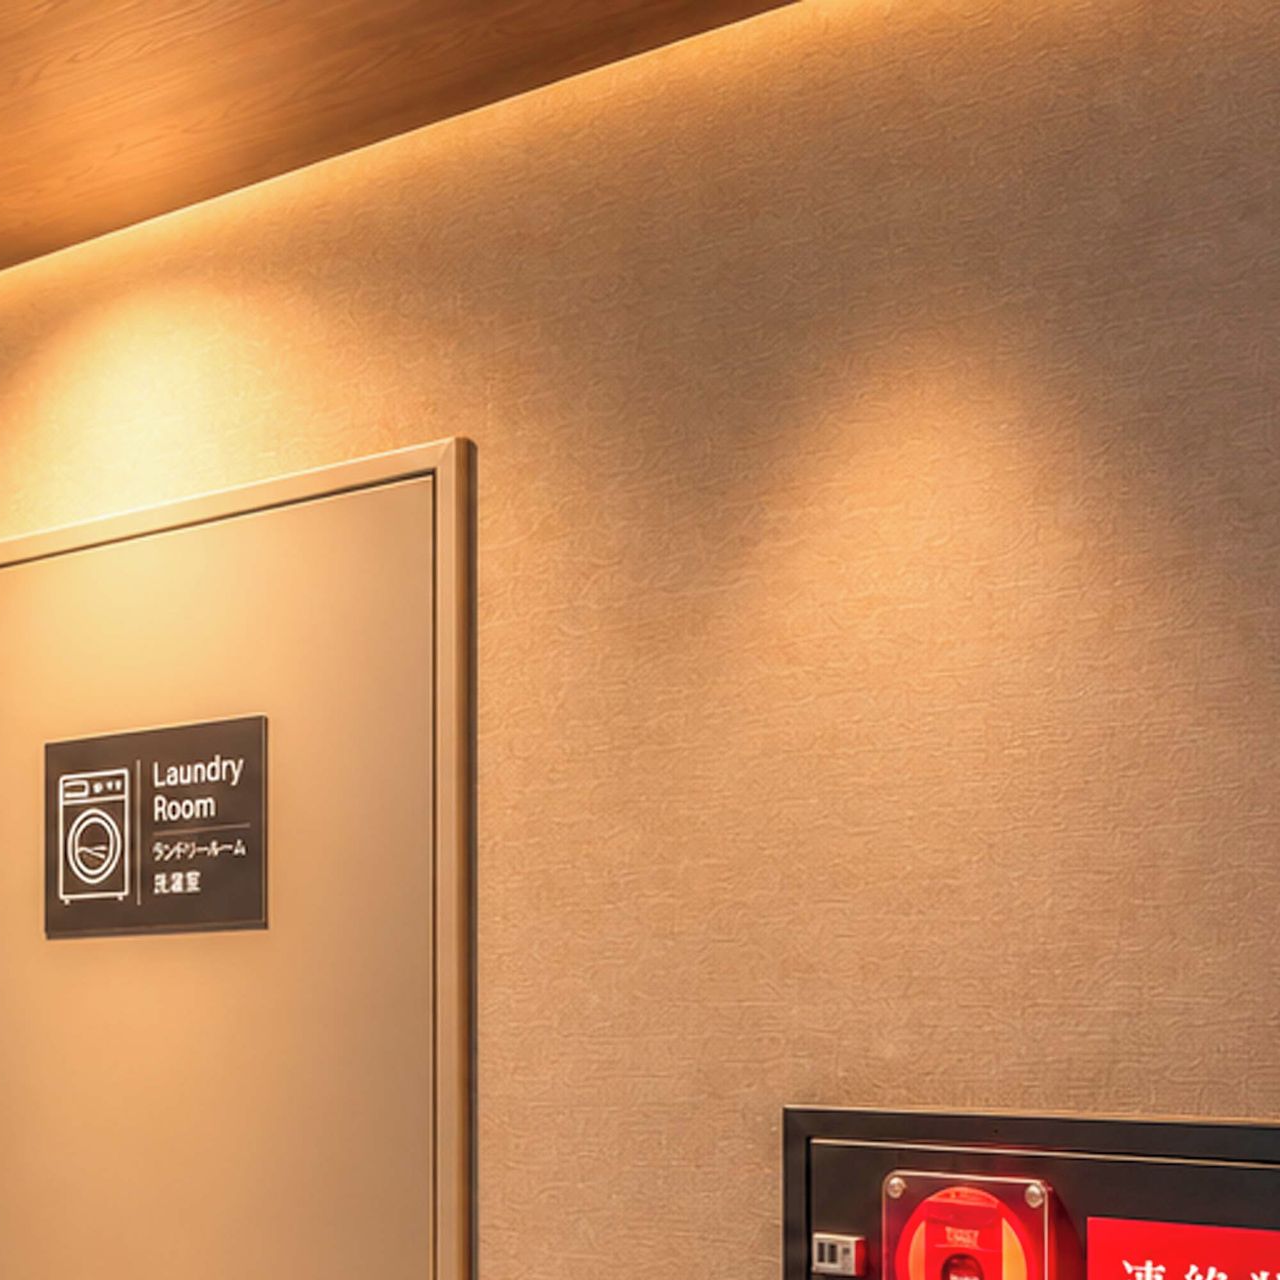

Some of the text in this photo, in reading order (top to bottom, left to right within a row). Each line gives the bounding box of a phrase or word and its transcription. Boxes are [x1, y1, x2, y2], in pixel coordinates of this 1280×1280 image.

[152, 754, 245, 787] Laundry
[152, 795, 217, 822] Room
[152, 838, 247, 862] ランドリールーム
